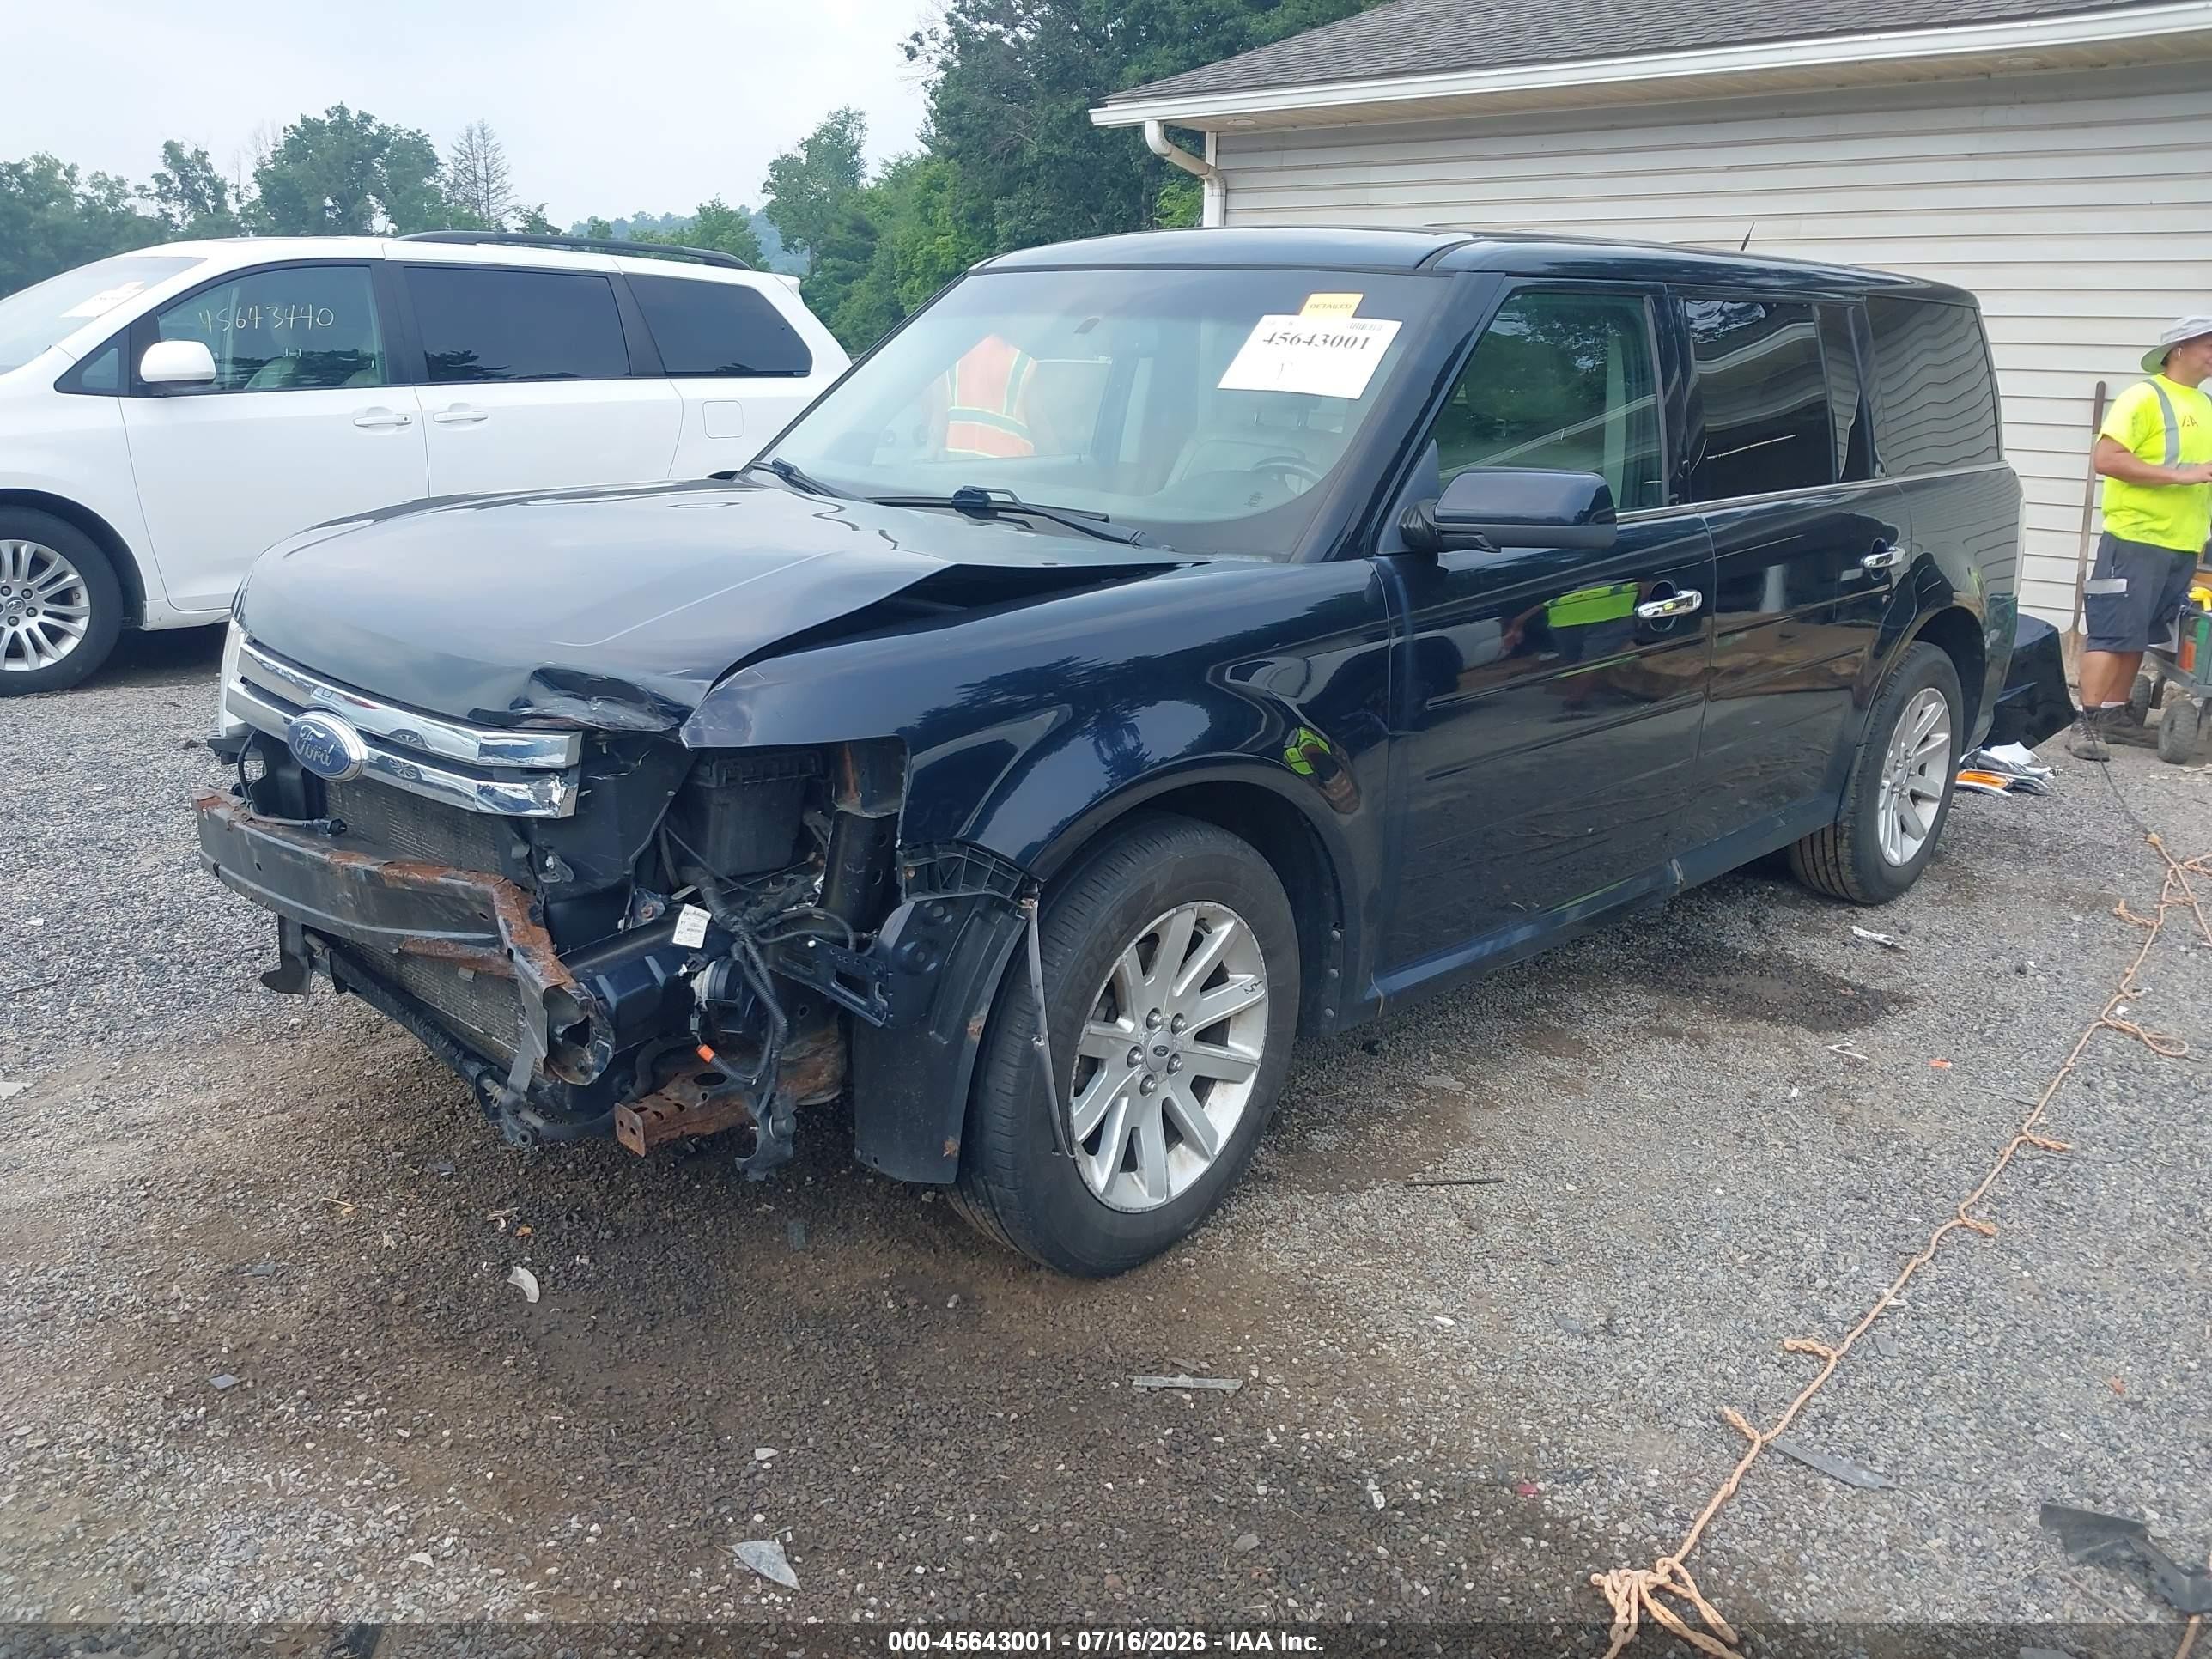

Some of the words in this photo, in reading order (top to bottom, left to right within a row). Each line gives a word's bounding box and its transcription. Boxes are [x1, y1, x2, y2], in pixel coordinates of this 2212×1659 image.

[198, 304, 334, 335] 45643440
[1261, 331, 1371, 350] 45643001
[295, 724, 335, 766] Ford
